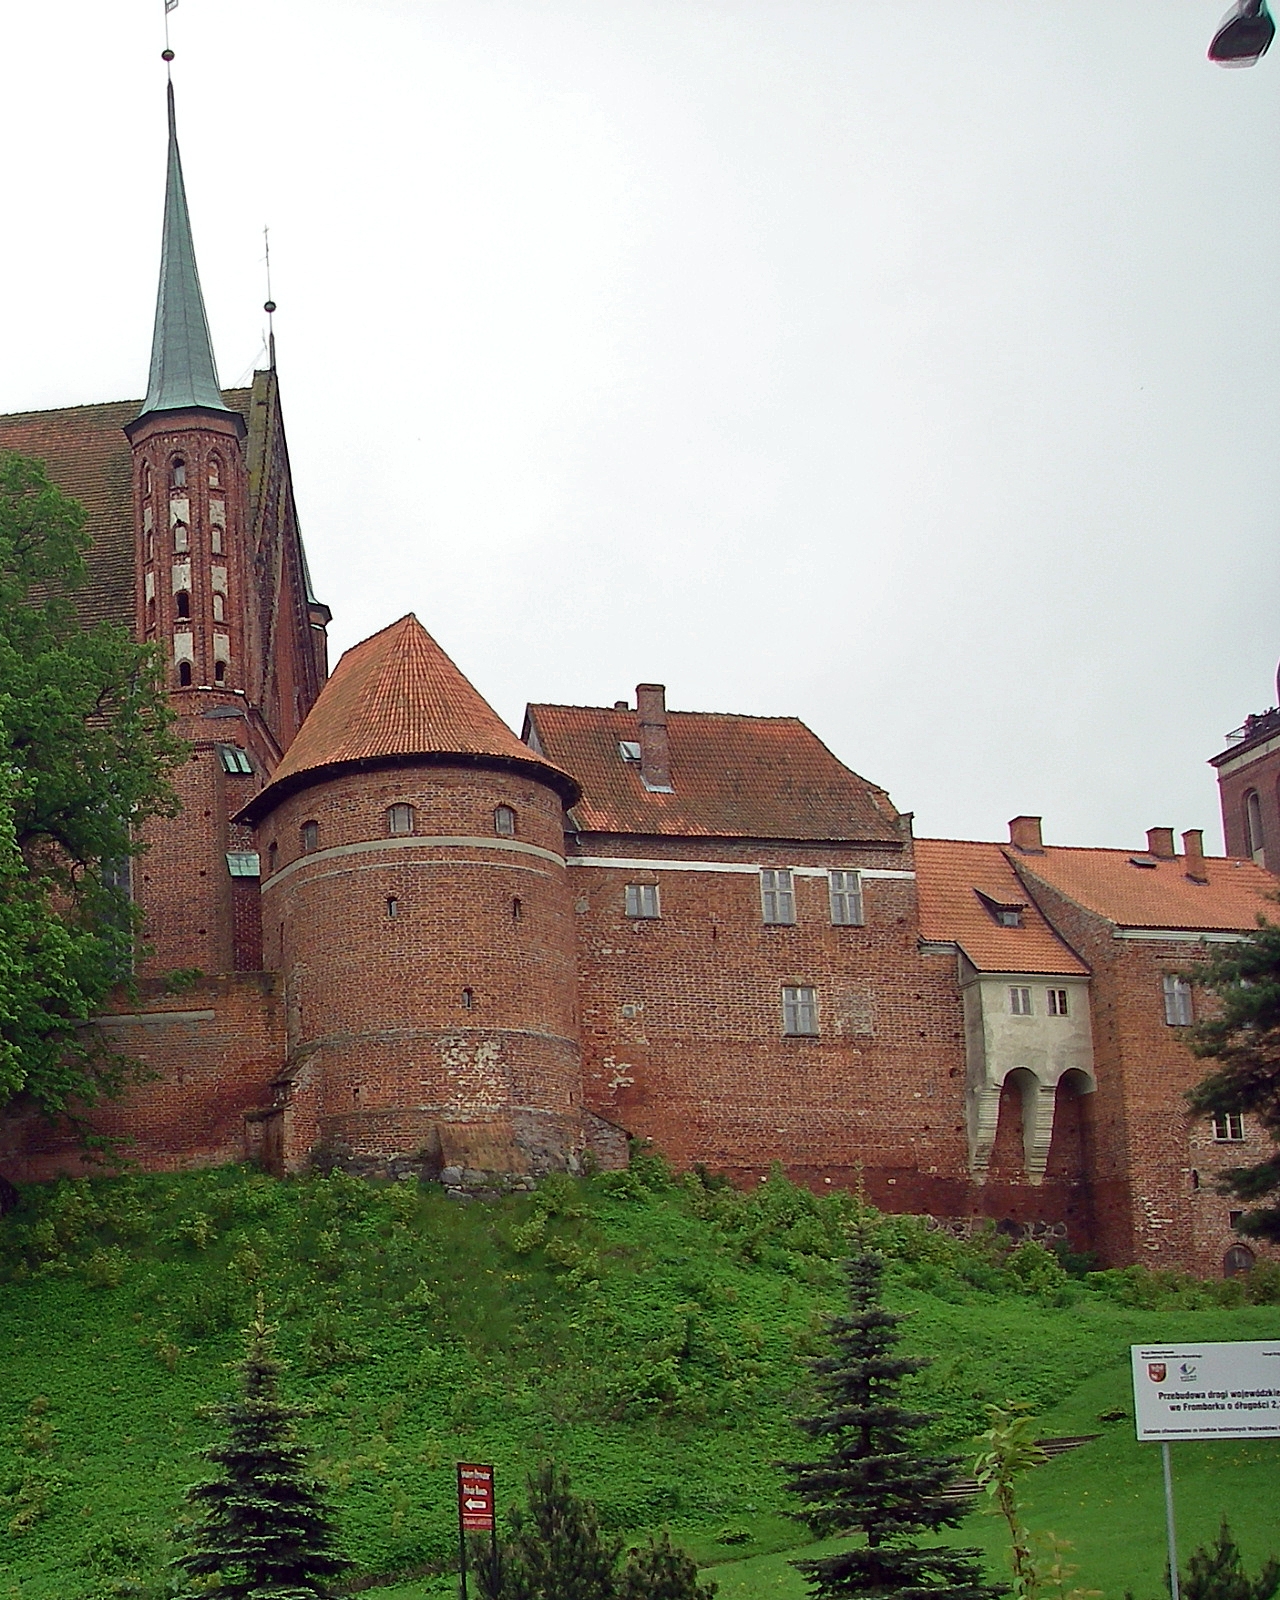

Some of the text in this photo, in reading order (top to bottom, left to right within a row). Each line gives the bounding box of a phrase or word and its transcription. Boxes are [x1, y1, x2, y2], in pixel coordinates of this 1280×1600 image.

[1158, 1391, 1206, 1400] Przebudowa
[1207, 1389, 1228, 1400] drogi
[1183, 1402, 1225, 1411] Fromborku
[1234, 1400, 1269, 1410] długości
